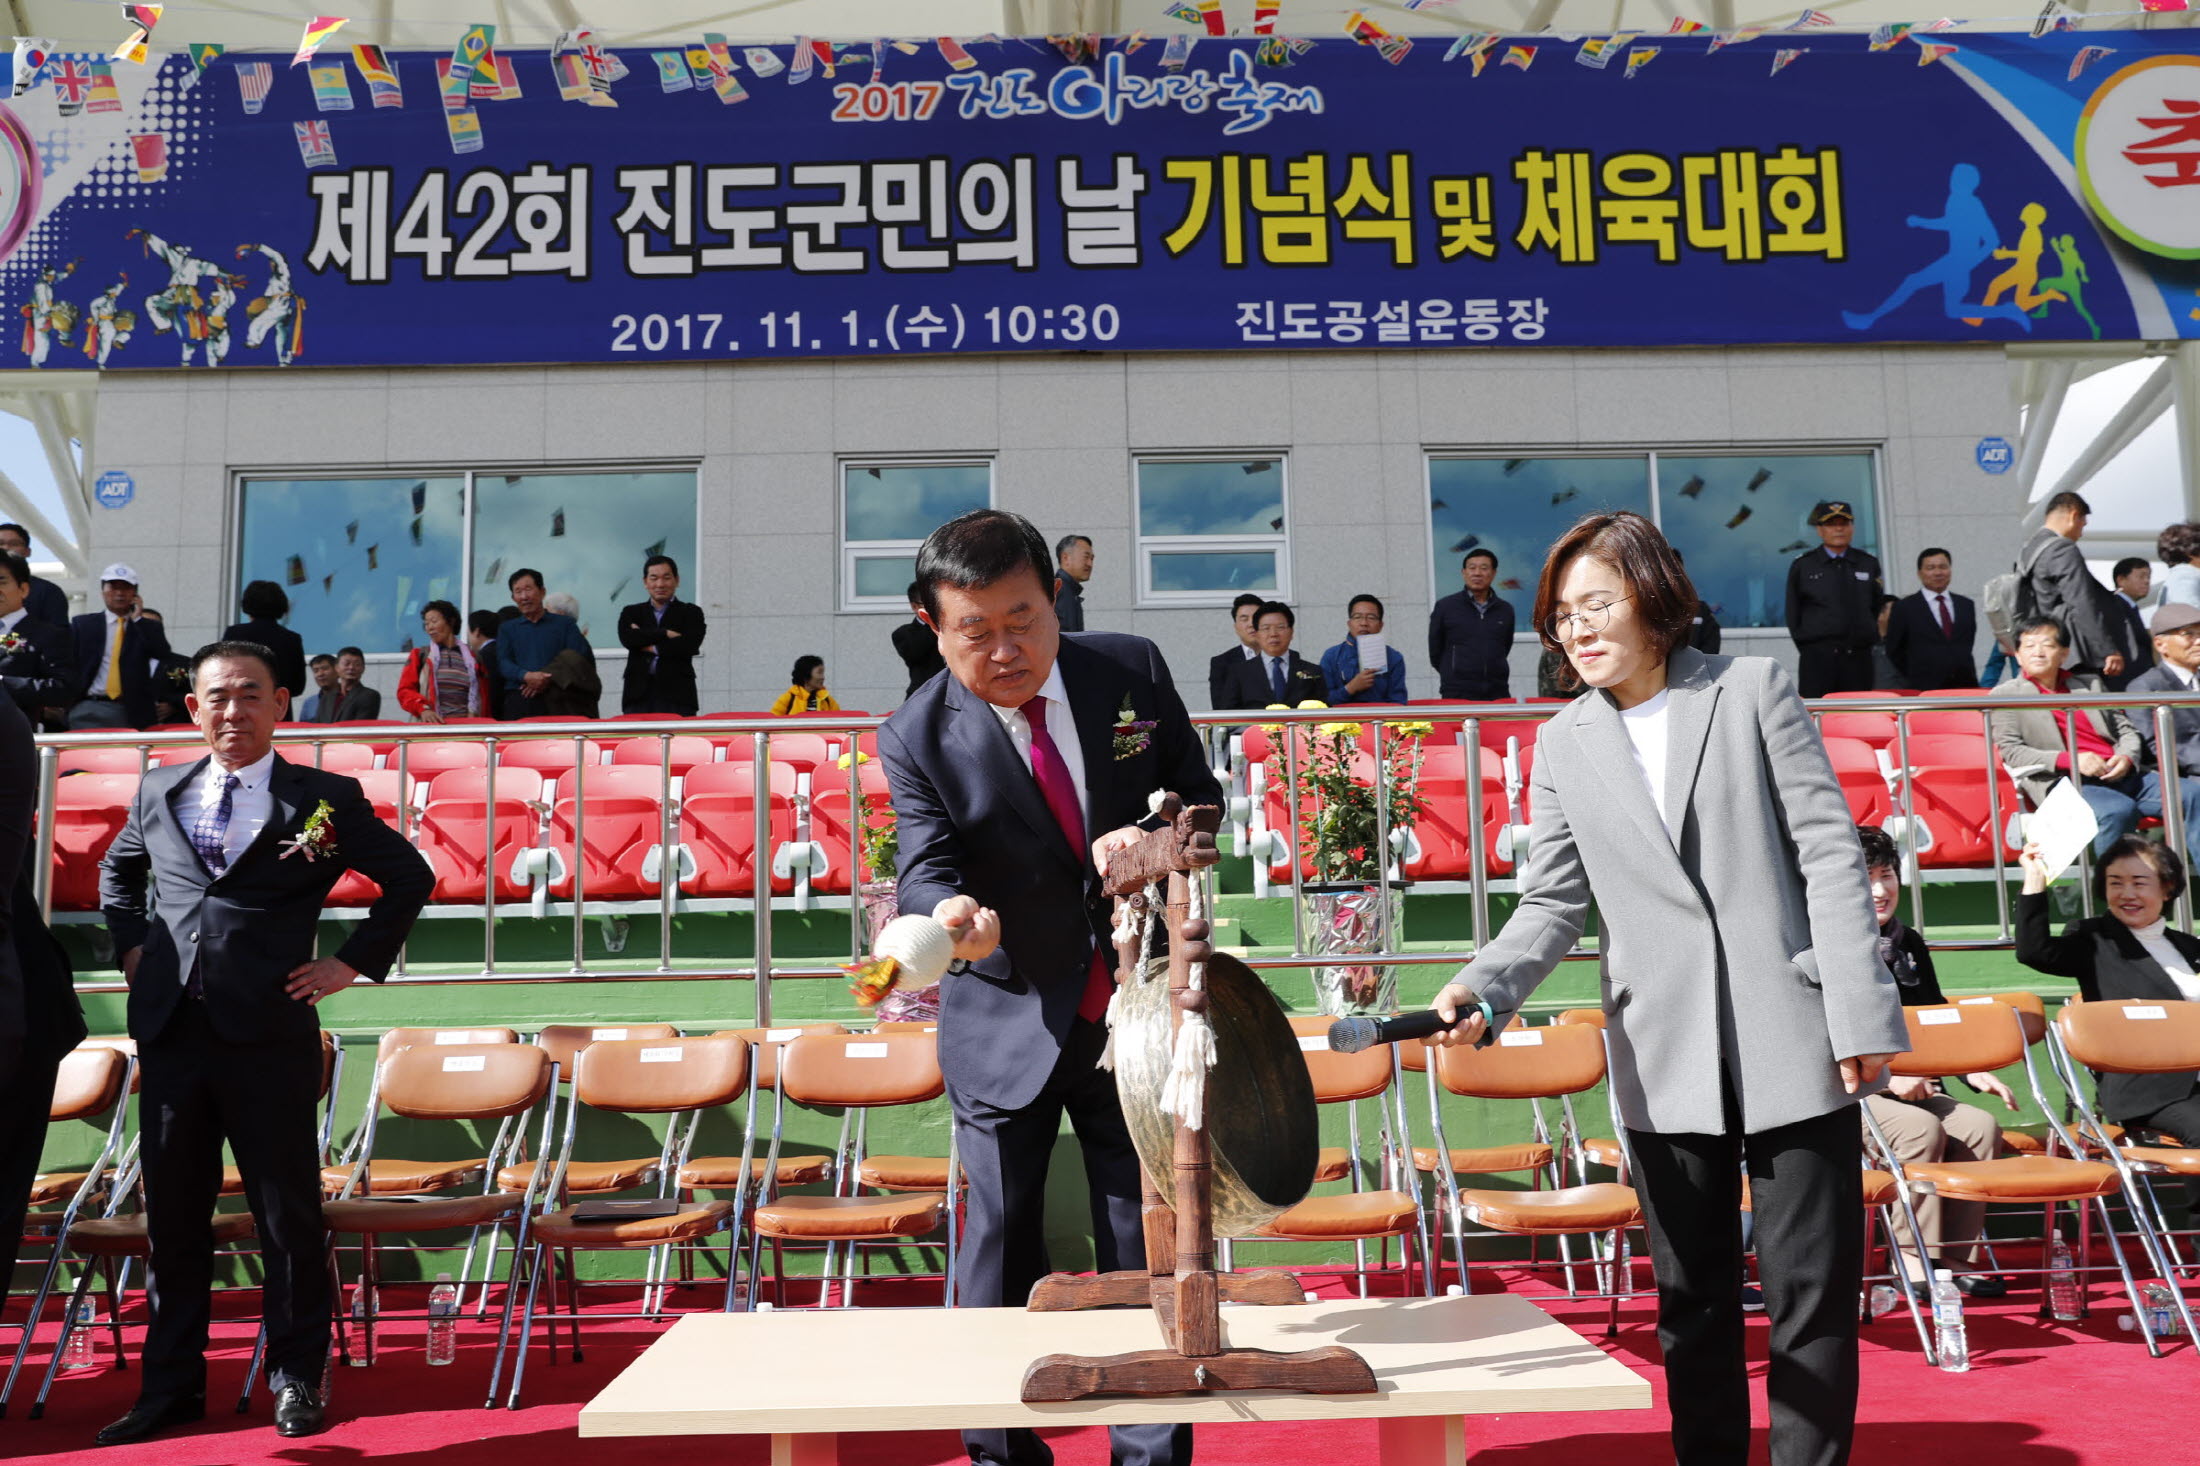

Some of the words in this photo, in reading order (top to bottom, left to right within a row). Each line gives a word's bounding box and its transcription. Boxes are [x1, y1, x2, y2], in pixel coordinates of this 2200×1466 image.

[833, 84, 943, 120] 2017
[947, 71, 1046, 118] 진도
[1050, 52, 1219, 124] 아리랑
[307, 166, 588, 282] 제42회
[615, 157, 1034, 276] 진도군민의
[1059, 155, 1146, 265] 날
[1164, 154, 1414, 265] 기념식
[1435, 176, 1494, 258] 및
[1514, 149, 1844, 262] 체육대회
[611, 314, 739, 352] 2017.
[760, 312, 821, 350] 11.
[983, 303, 1121, 343] 10:30
[1235, 297, 1549, 345] 진도공설운동장
[1981, 448, 2007, 462] ADT
[101, 482, 129, 497] ADT
